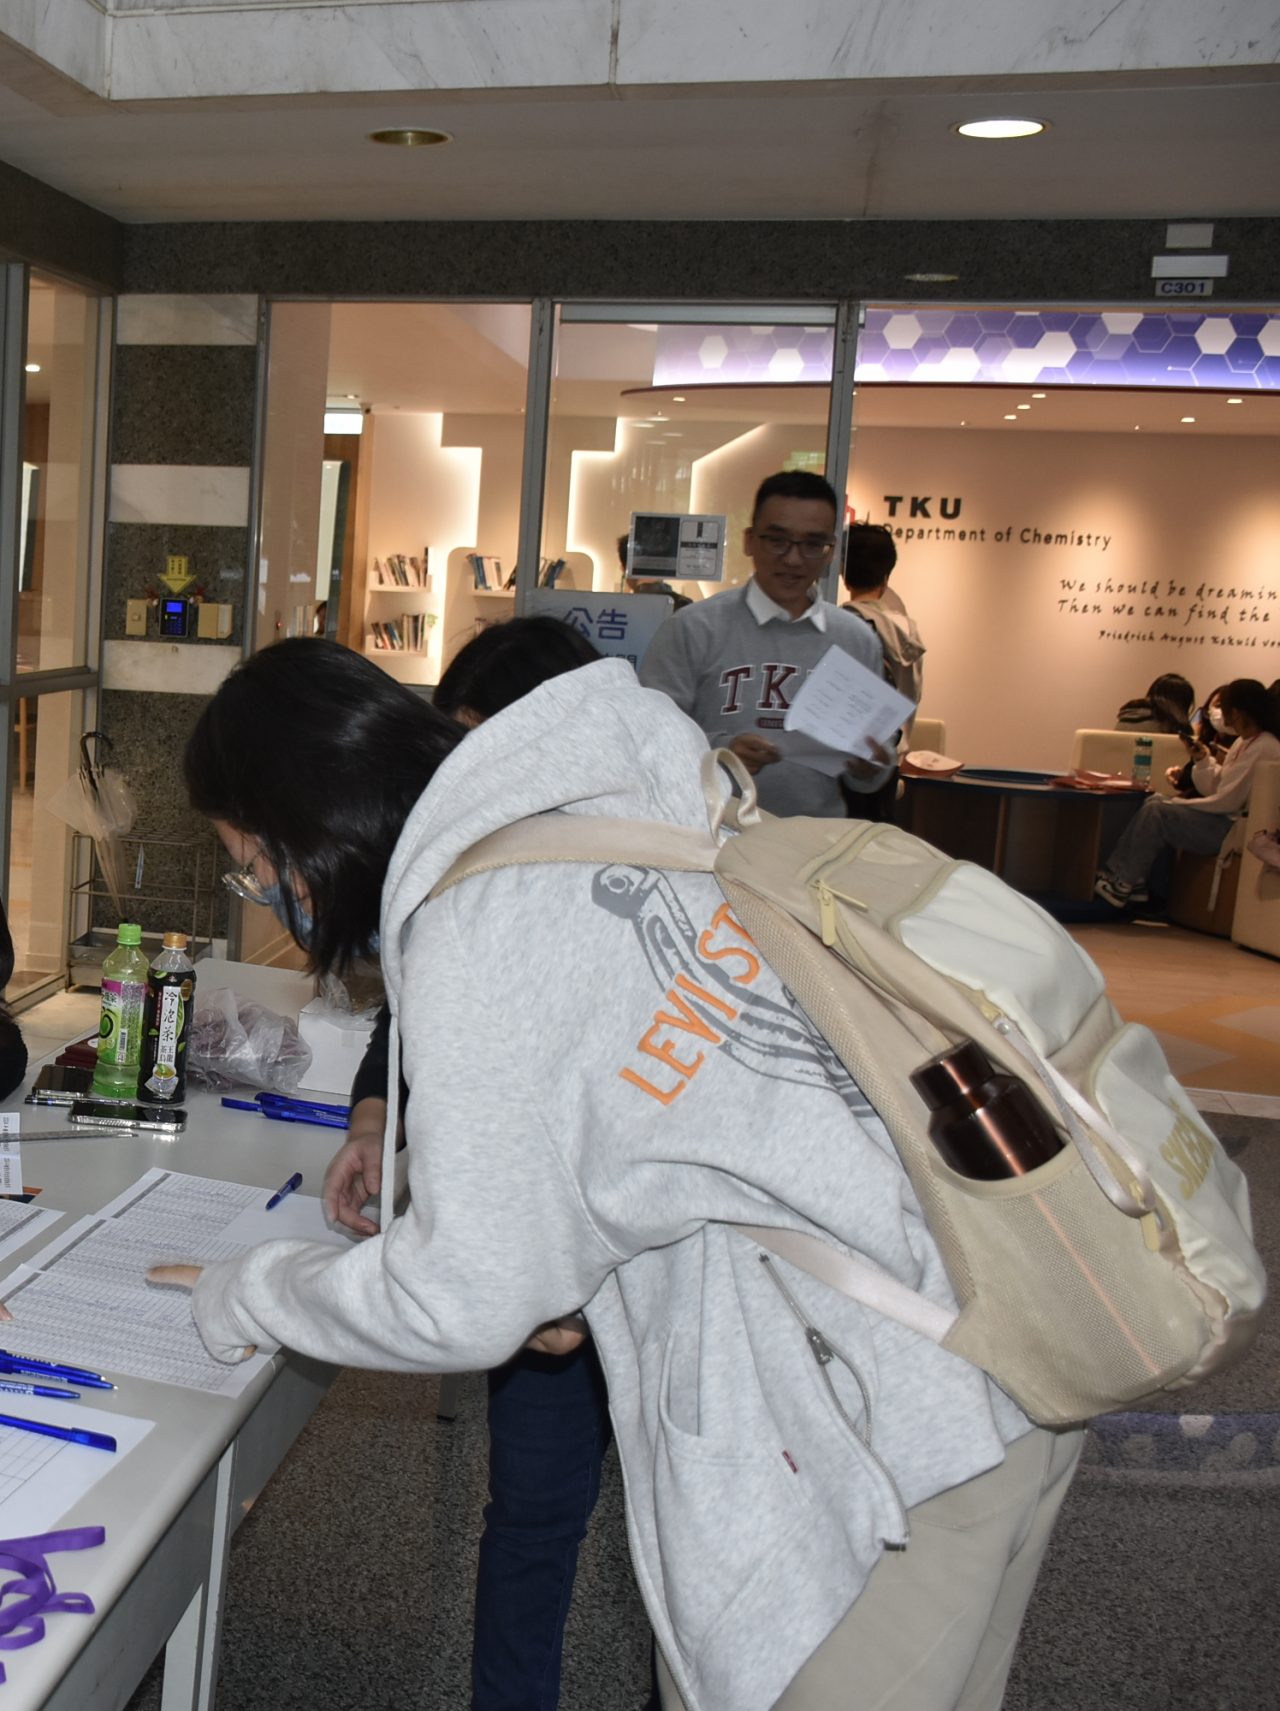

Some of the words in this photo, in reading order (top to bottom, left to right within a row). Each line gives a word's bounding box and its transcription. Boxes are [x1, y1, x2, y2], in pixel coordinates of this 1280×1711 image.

[1161, 282, 1206, 294] C301
[884, 496, 962, 519] TKU
[994, 526, 1012, 542] of
[1020, 528, 1112, 551] Chemistry
[1060, 579, 1086, 592] We
[1096, 578, 1160, 599] should
[1168, 579, 1186, 596] be
[563, 607, 629, 640] 公告
[1058, 598, 1102, 614] Then
[1113, 603, 1134, 616] we
[1144, 605, 1179, 617] can
[1184, 603, 1228, 626] find
[1239, 605, 1270, 622] the
[1099, 630, 1154, 644] Friedrich
[1160, 632, 1205, 648] August
[719, 662, 818, 716] TK
[162, 991, 178, 1041] 冷泡茶
[617, 973, 737, 1105] LEVI
